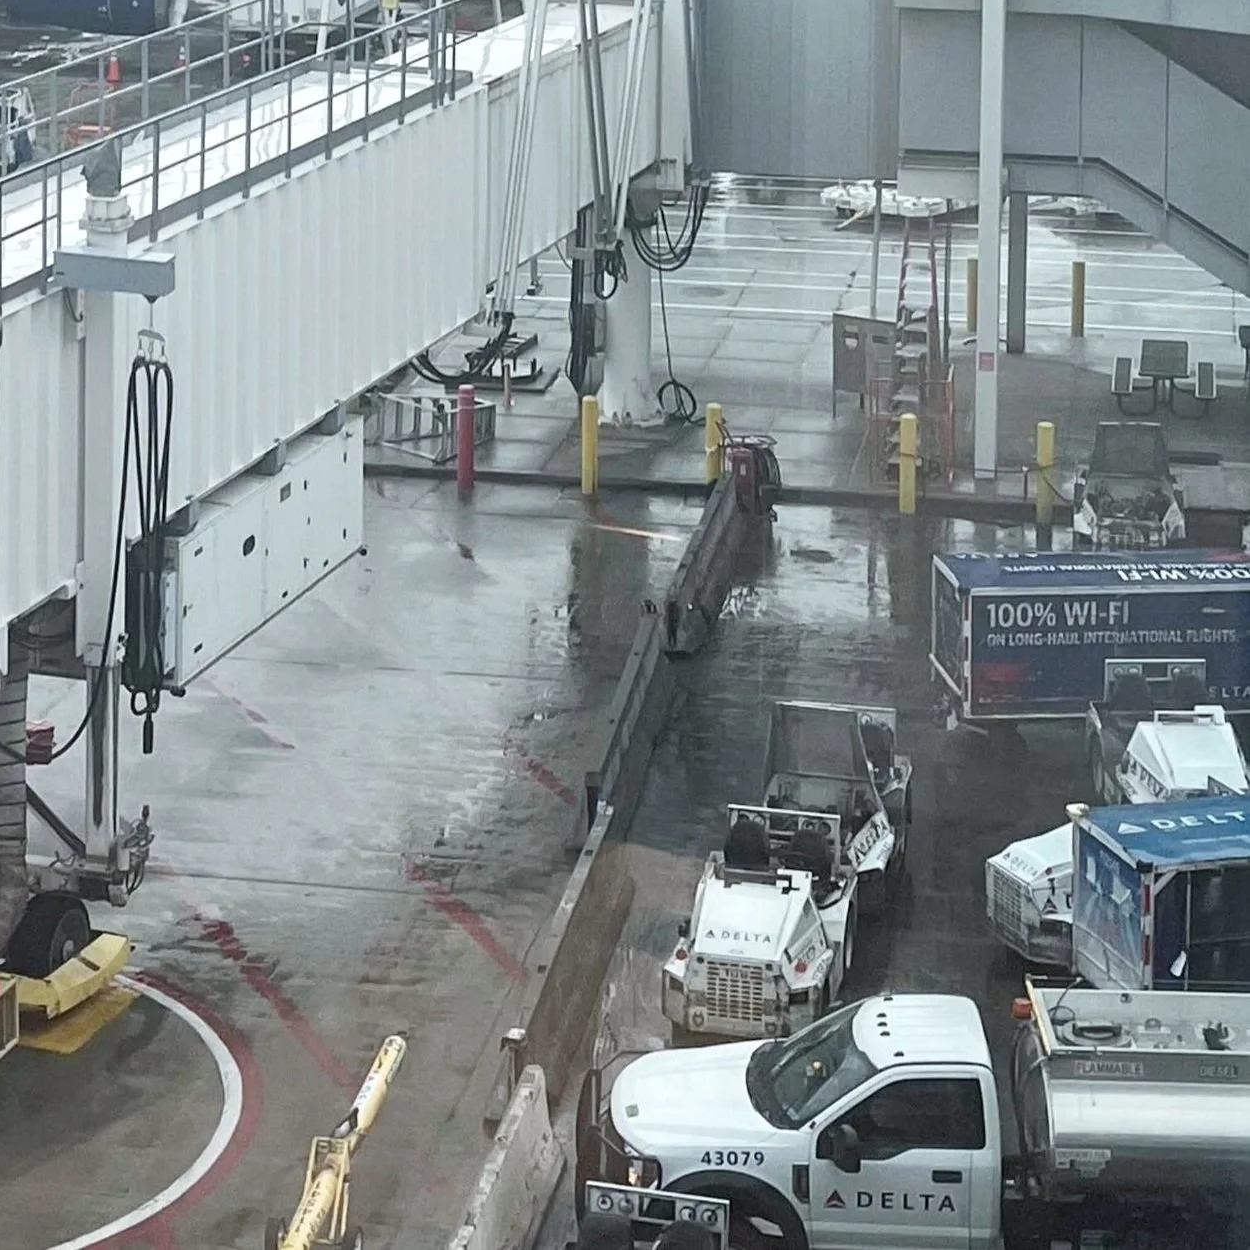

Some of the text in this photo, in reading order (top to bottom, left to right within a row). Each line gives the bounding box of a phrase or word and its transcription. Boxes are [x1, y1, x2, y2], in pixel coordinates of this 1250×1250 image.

[1117, 568, 1188, 581] WI-FI
[986, 600, 1130, 628] 100% WI-FI
[986, 628, 1237, 648] ON LONG-HAUL INTERNATIONAL FLIGHTS
[721, 930, 771, 943] DELTA
[700, 1151, 765, 1166] 43079
[856, 1191, 956, 1212] DELTA
